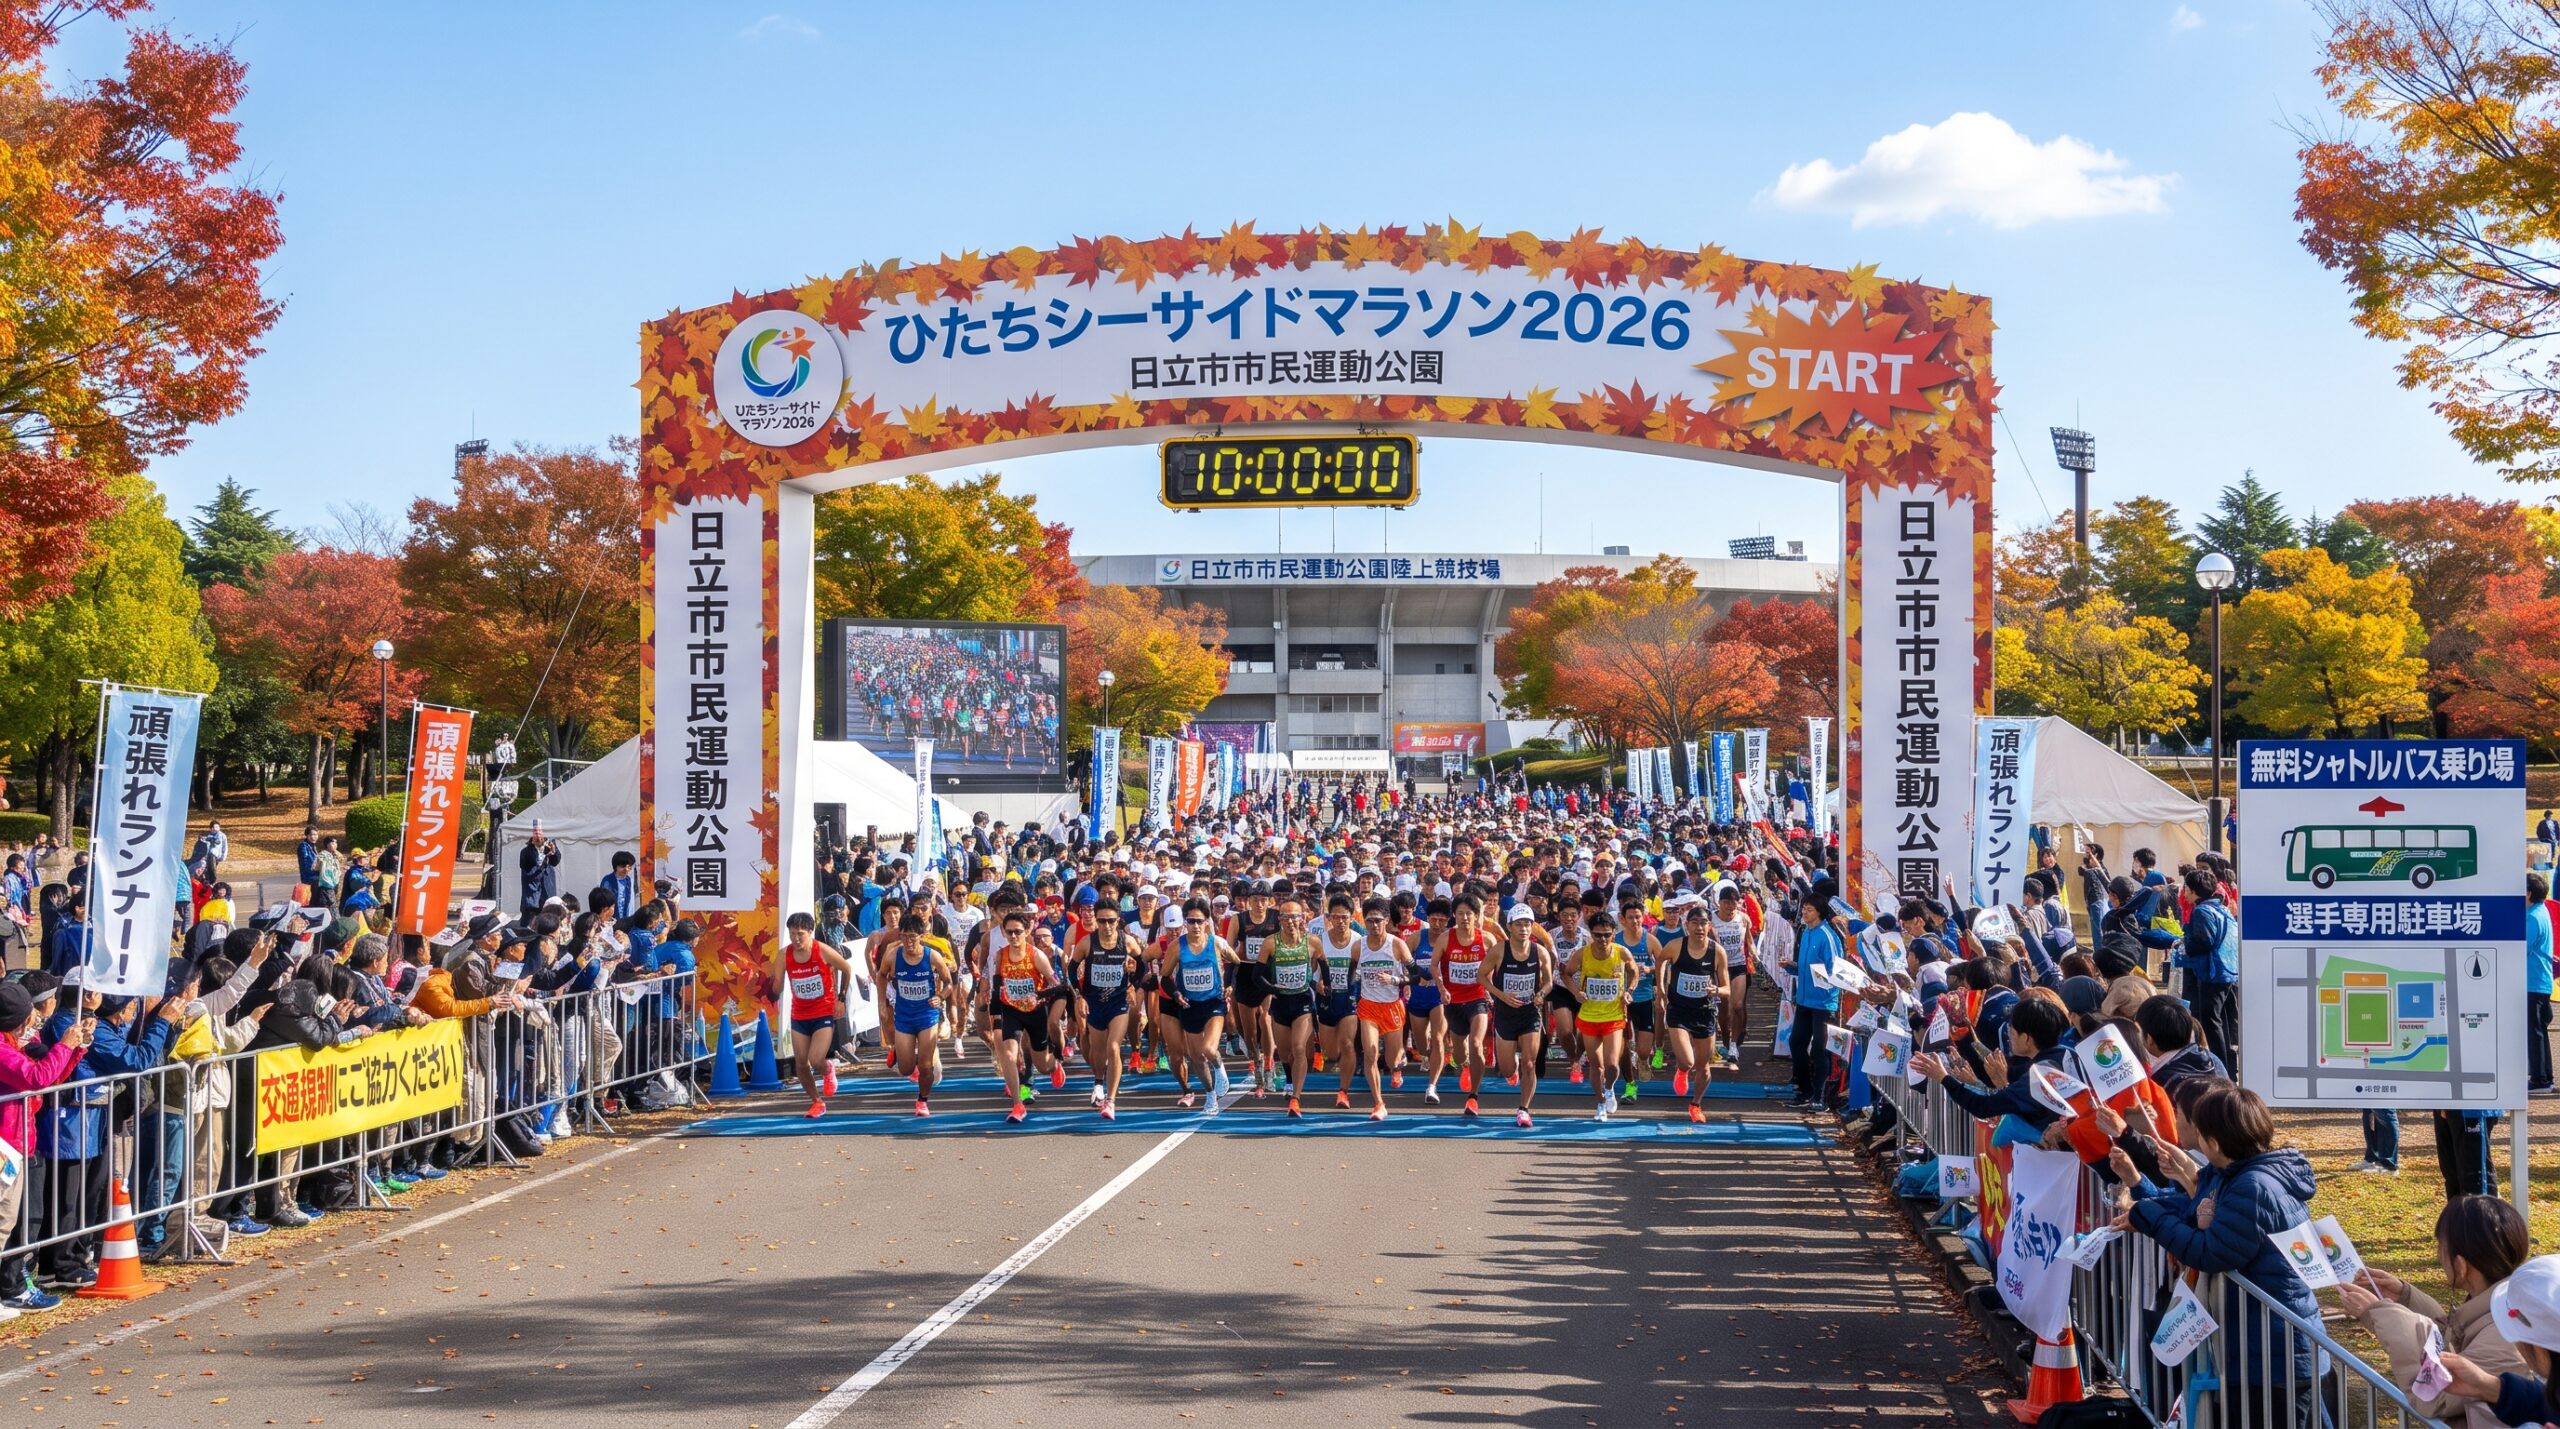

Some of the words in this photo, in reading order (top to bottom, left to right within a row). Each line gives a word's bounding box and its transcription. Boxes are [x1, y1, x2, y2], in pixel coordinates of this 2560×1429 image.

[885, 286, 1690, 364] ひたちシーサイドマラソン2026
[1130, 349, 1444, 389] 日立市市民運動公園
[1746, 346, 1913, 395] START
[735, 401, 821, 417] ひたちシーサイド
[739, 416, 815, 431] マラソン2026
[1196, 445, 1400, 496] 10:00:00
[1191, 558, 1501, 581] 日立市市民運動公園陸上競技場
[686, 511, 729, 899] 日立市市民運動公園
[1895, 500, 1941, 899] 日立市市民運動公園
[2251, 747, 2515, 783] 無料シャトルバス乗り場
[2285, 902, 2483, 936] 選手専用駐車場
